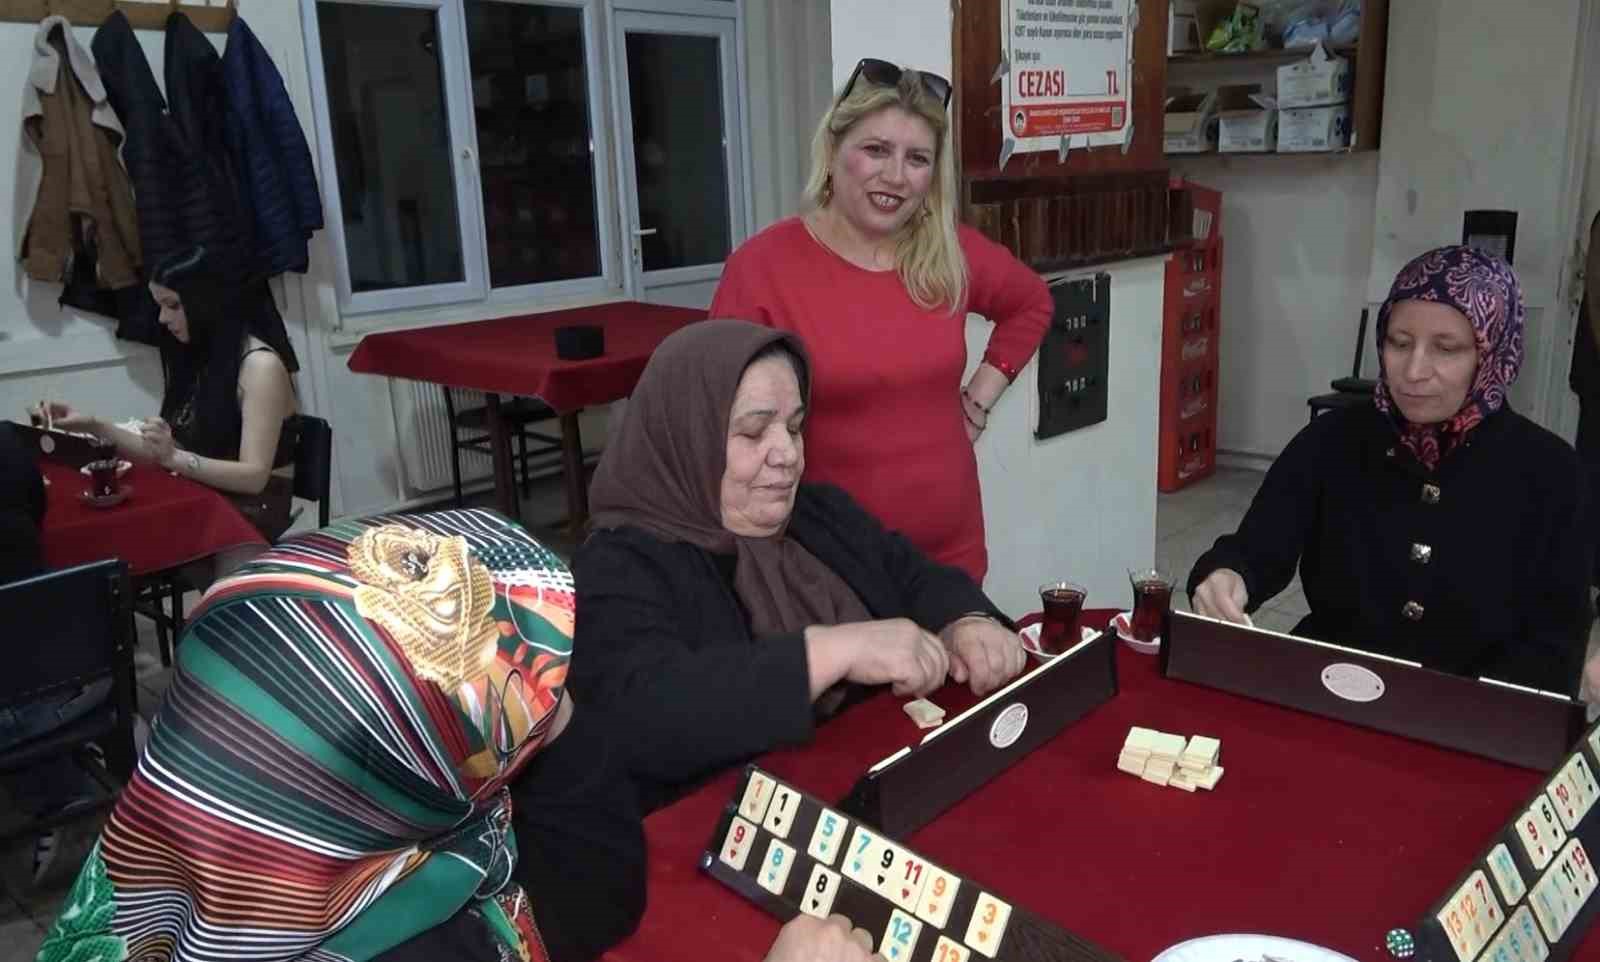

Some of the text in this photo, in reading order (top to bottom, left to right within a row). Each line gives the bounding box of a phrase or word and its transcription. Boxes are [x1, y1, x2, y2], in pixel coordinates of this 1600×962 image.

[1019, 70, 1119, 97] CEZASI TL
[779, 793, 789, 812] 1
[1556, 784, 1570, 806] 10
[1542, 803, 1553, 824] 6
[734, 826, 746, 844] 9
[822, 815, 838, 837] 5
[1527, 821, 1538, 841] 9
[857, 833, 872, 854] 7
[881, 849, 895, 869] 9
[905, 859, 923, 885] 11
[1562, 859, 1577, 883] 11
[816, 874, 829, 893] 8
[932, 876, 947, 897] 9
[982, 903, 998, 924] 3
[1461, 895, 1478, 920] 12
[892, 917, 913, 944] 12
[1446, 911, 1464, 939] 13
